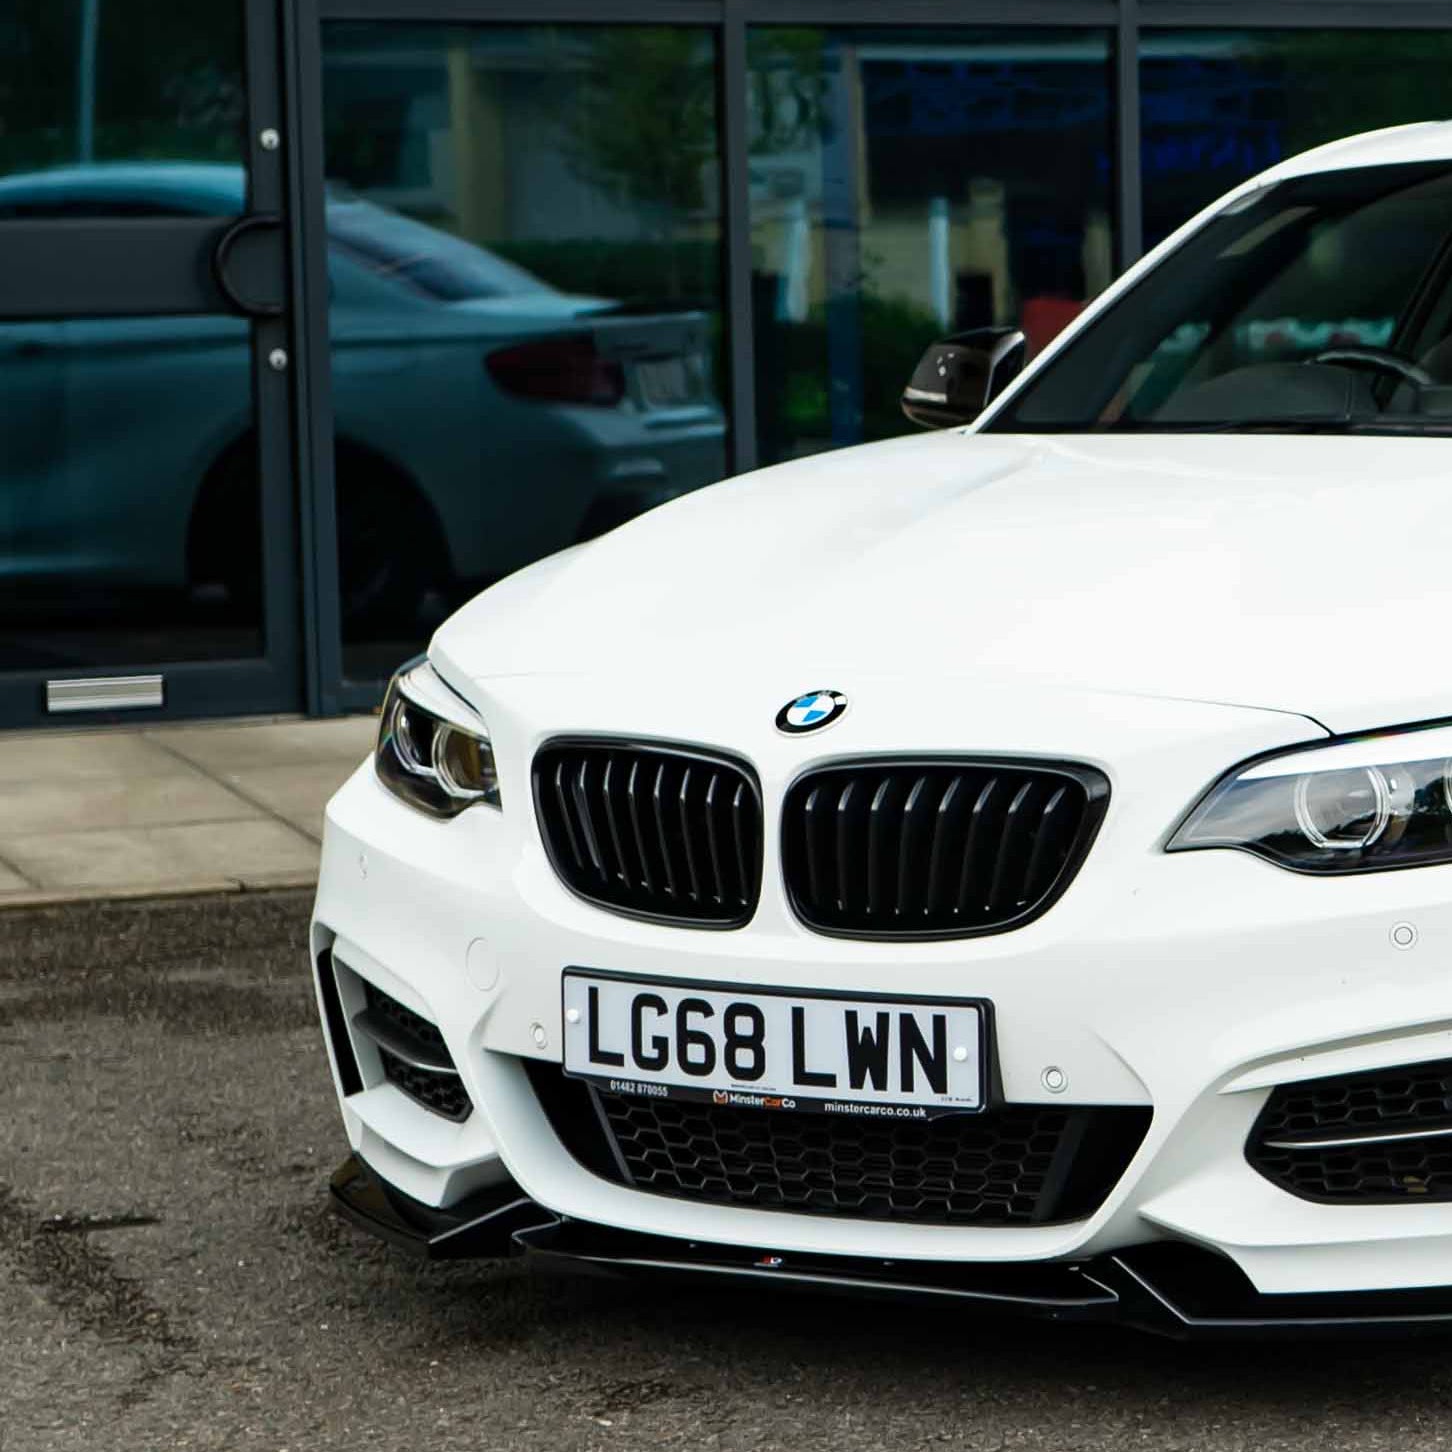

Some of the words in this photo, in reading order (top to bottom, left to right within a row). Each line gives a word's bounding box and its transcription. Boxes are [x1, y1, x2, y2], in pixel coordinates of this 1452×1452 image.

[588, 986, 766, 1082] LG68
[792, 1006, 948, 1095] LWN
[824, 1102, 927, 1118] minstercarco.co.uk
